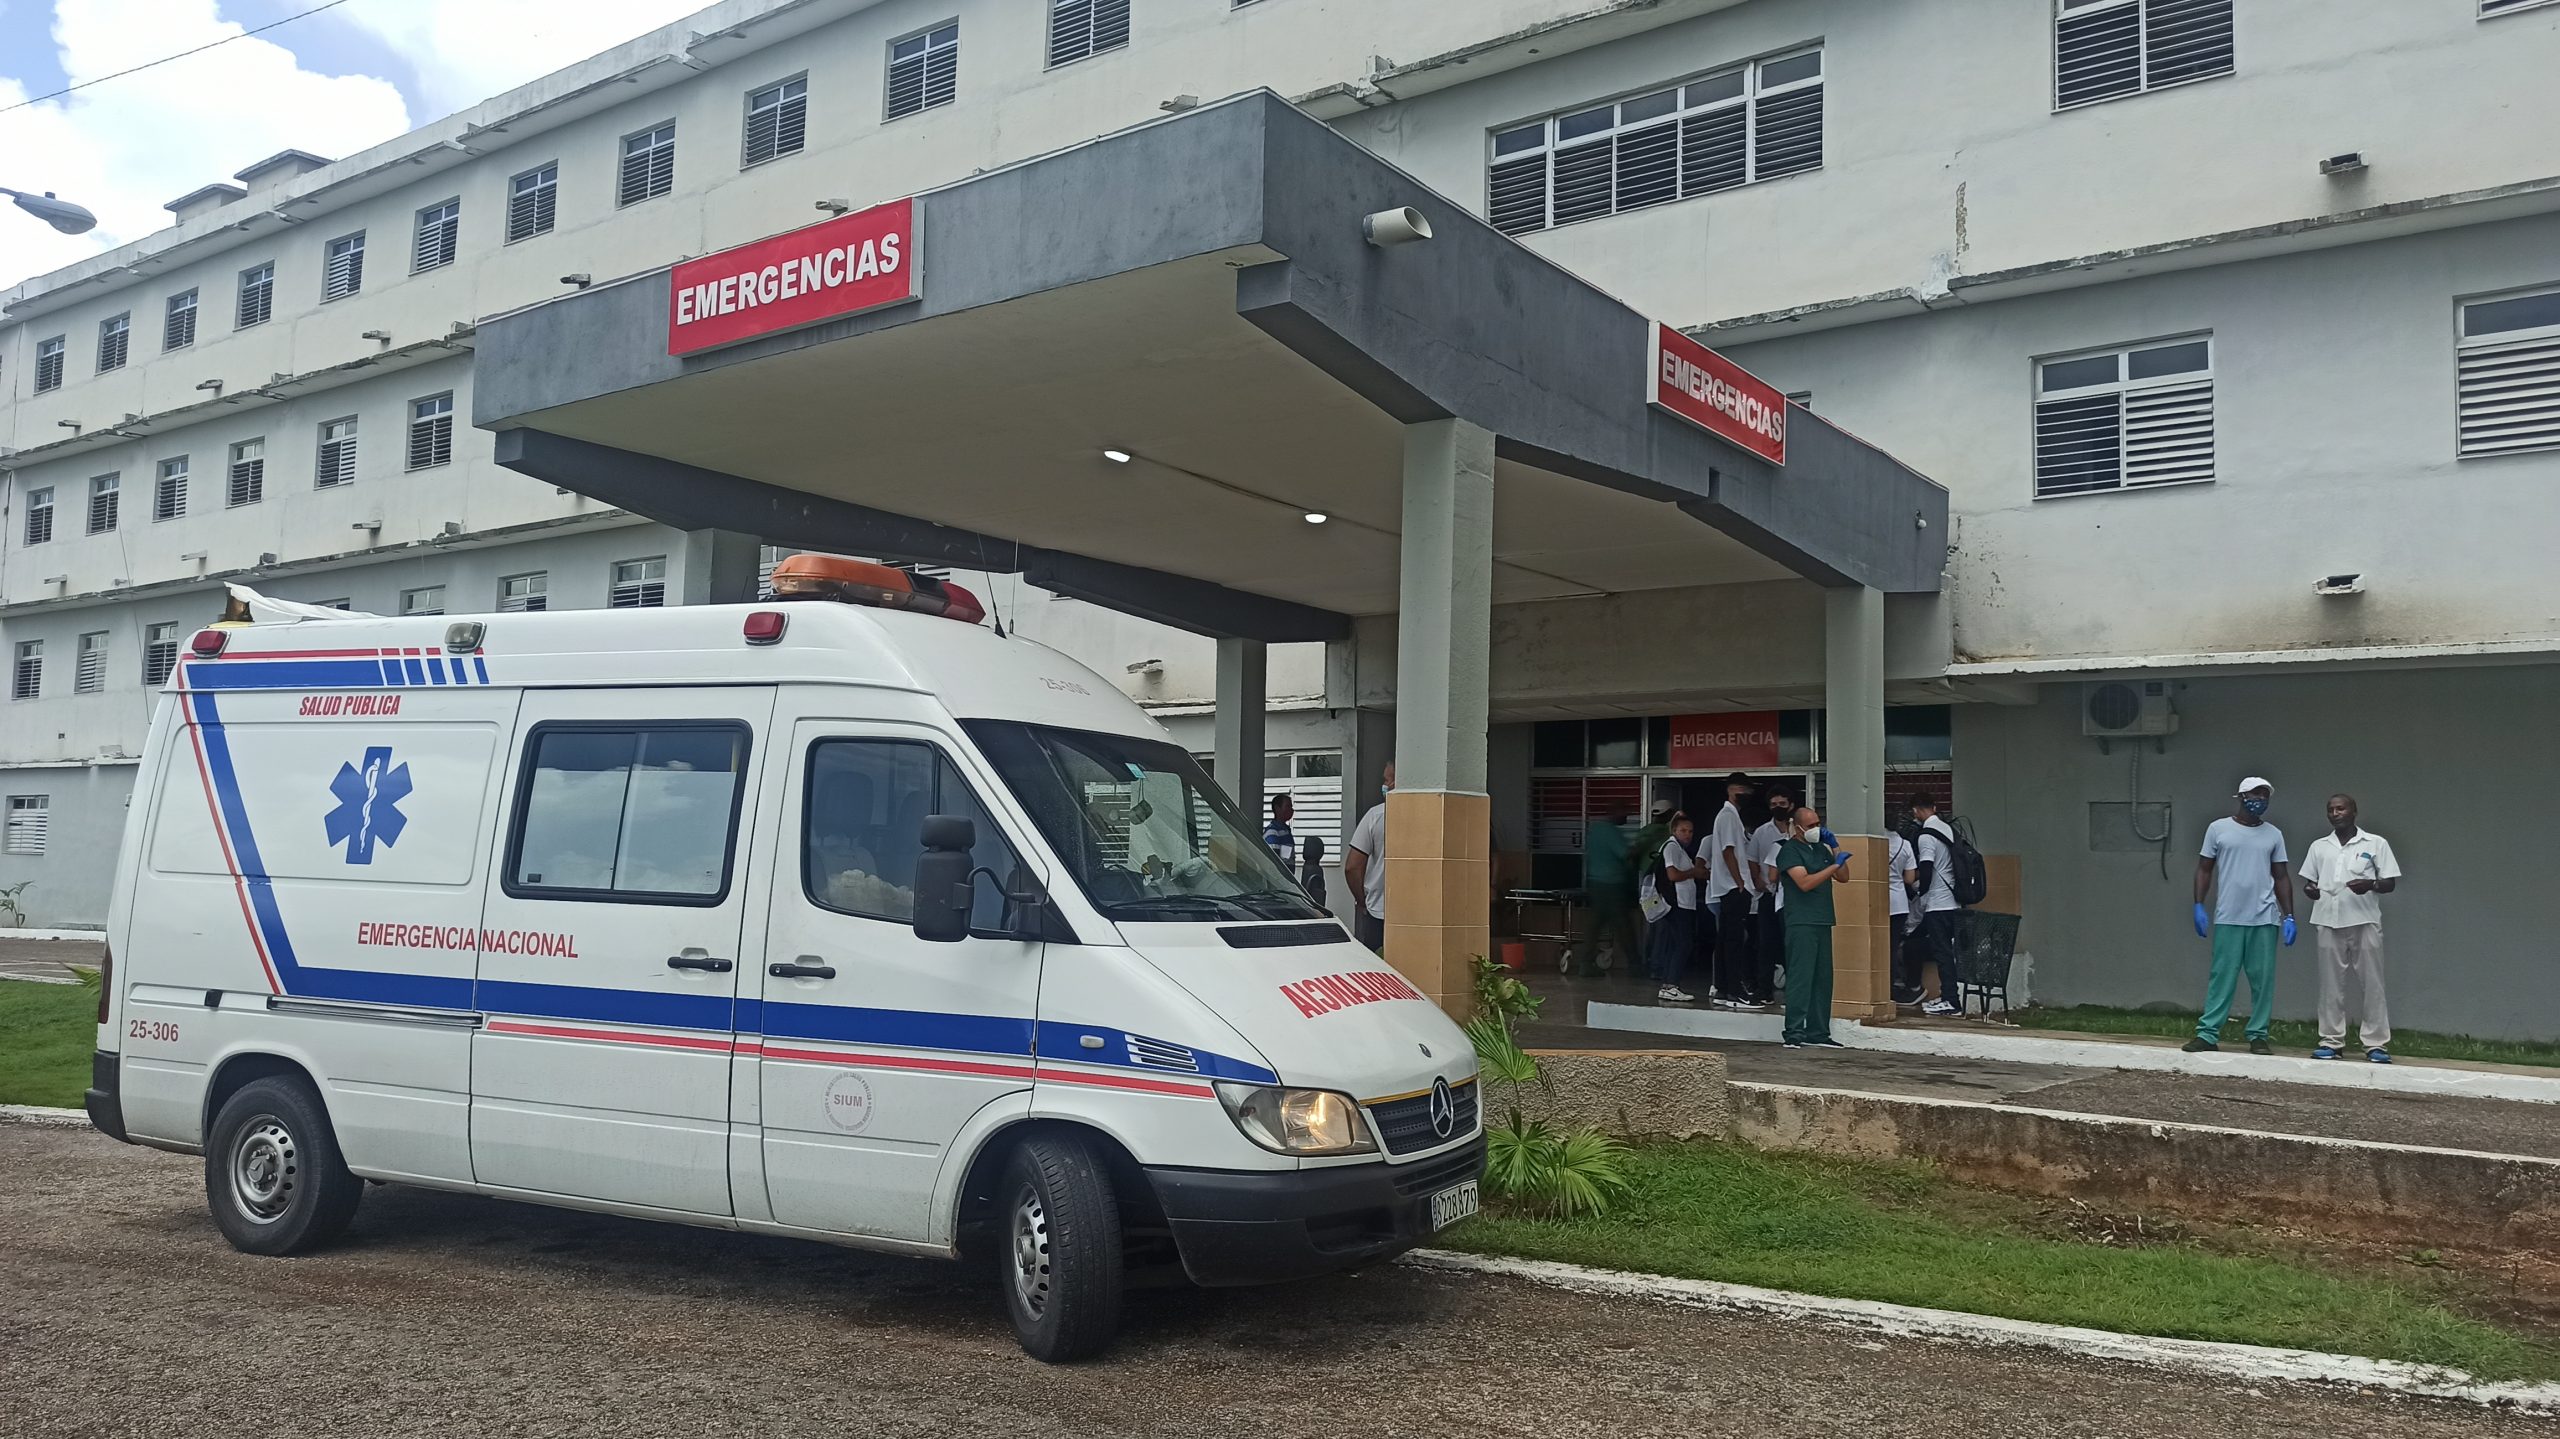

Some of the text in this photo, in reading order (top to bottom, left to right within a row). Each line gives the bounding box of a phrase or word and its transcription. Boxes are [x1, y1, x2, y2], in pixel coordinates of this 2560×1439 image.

[676, 232, 901, 326] EMERGENCIAS
[1662, 348, 1783, 443] EMERGENCIAS
[299, 694, 402, 716] SALUD PUBLICA
[1672, 731, 1776, 748] EMERGENCIA
[357, 922, 579, 959] EMERGENCIA NACIONAL
[129, 1019, 179, 1042] 25-306
[833, 1093, 863, 1108] SIUM
